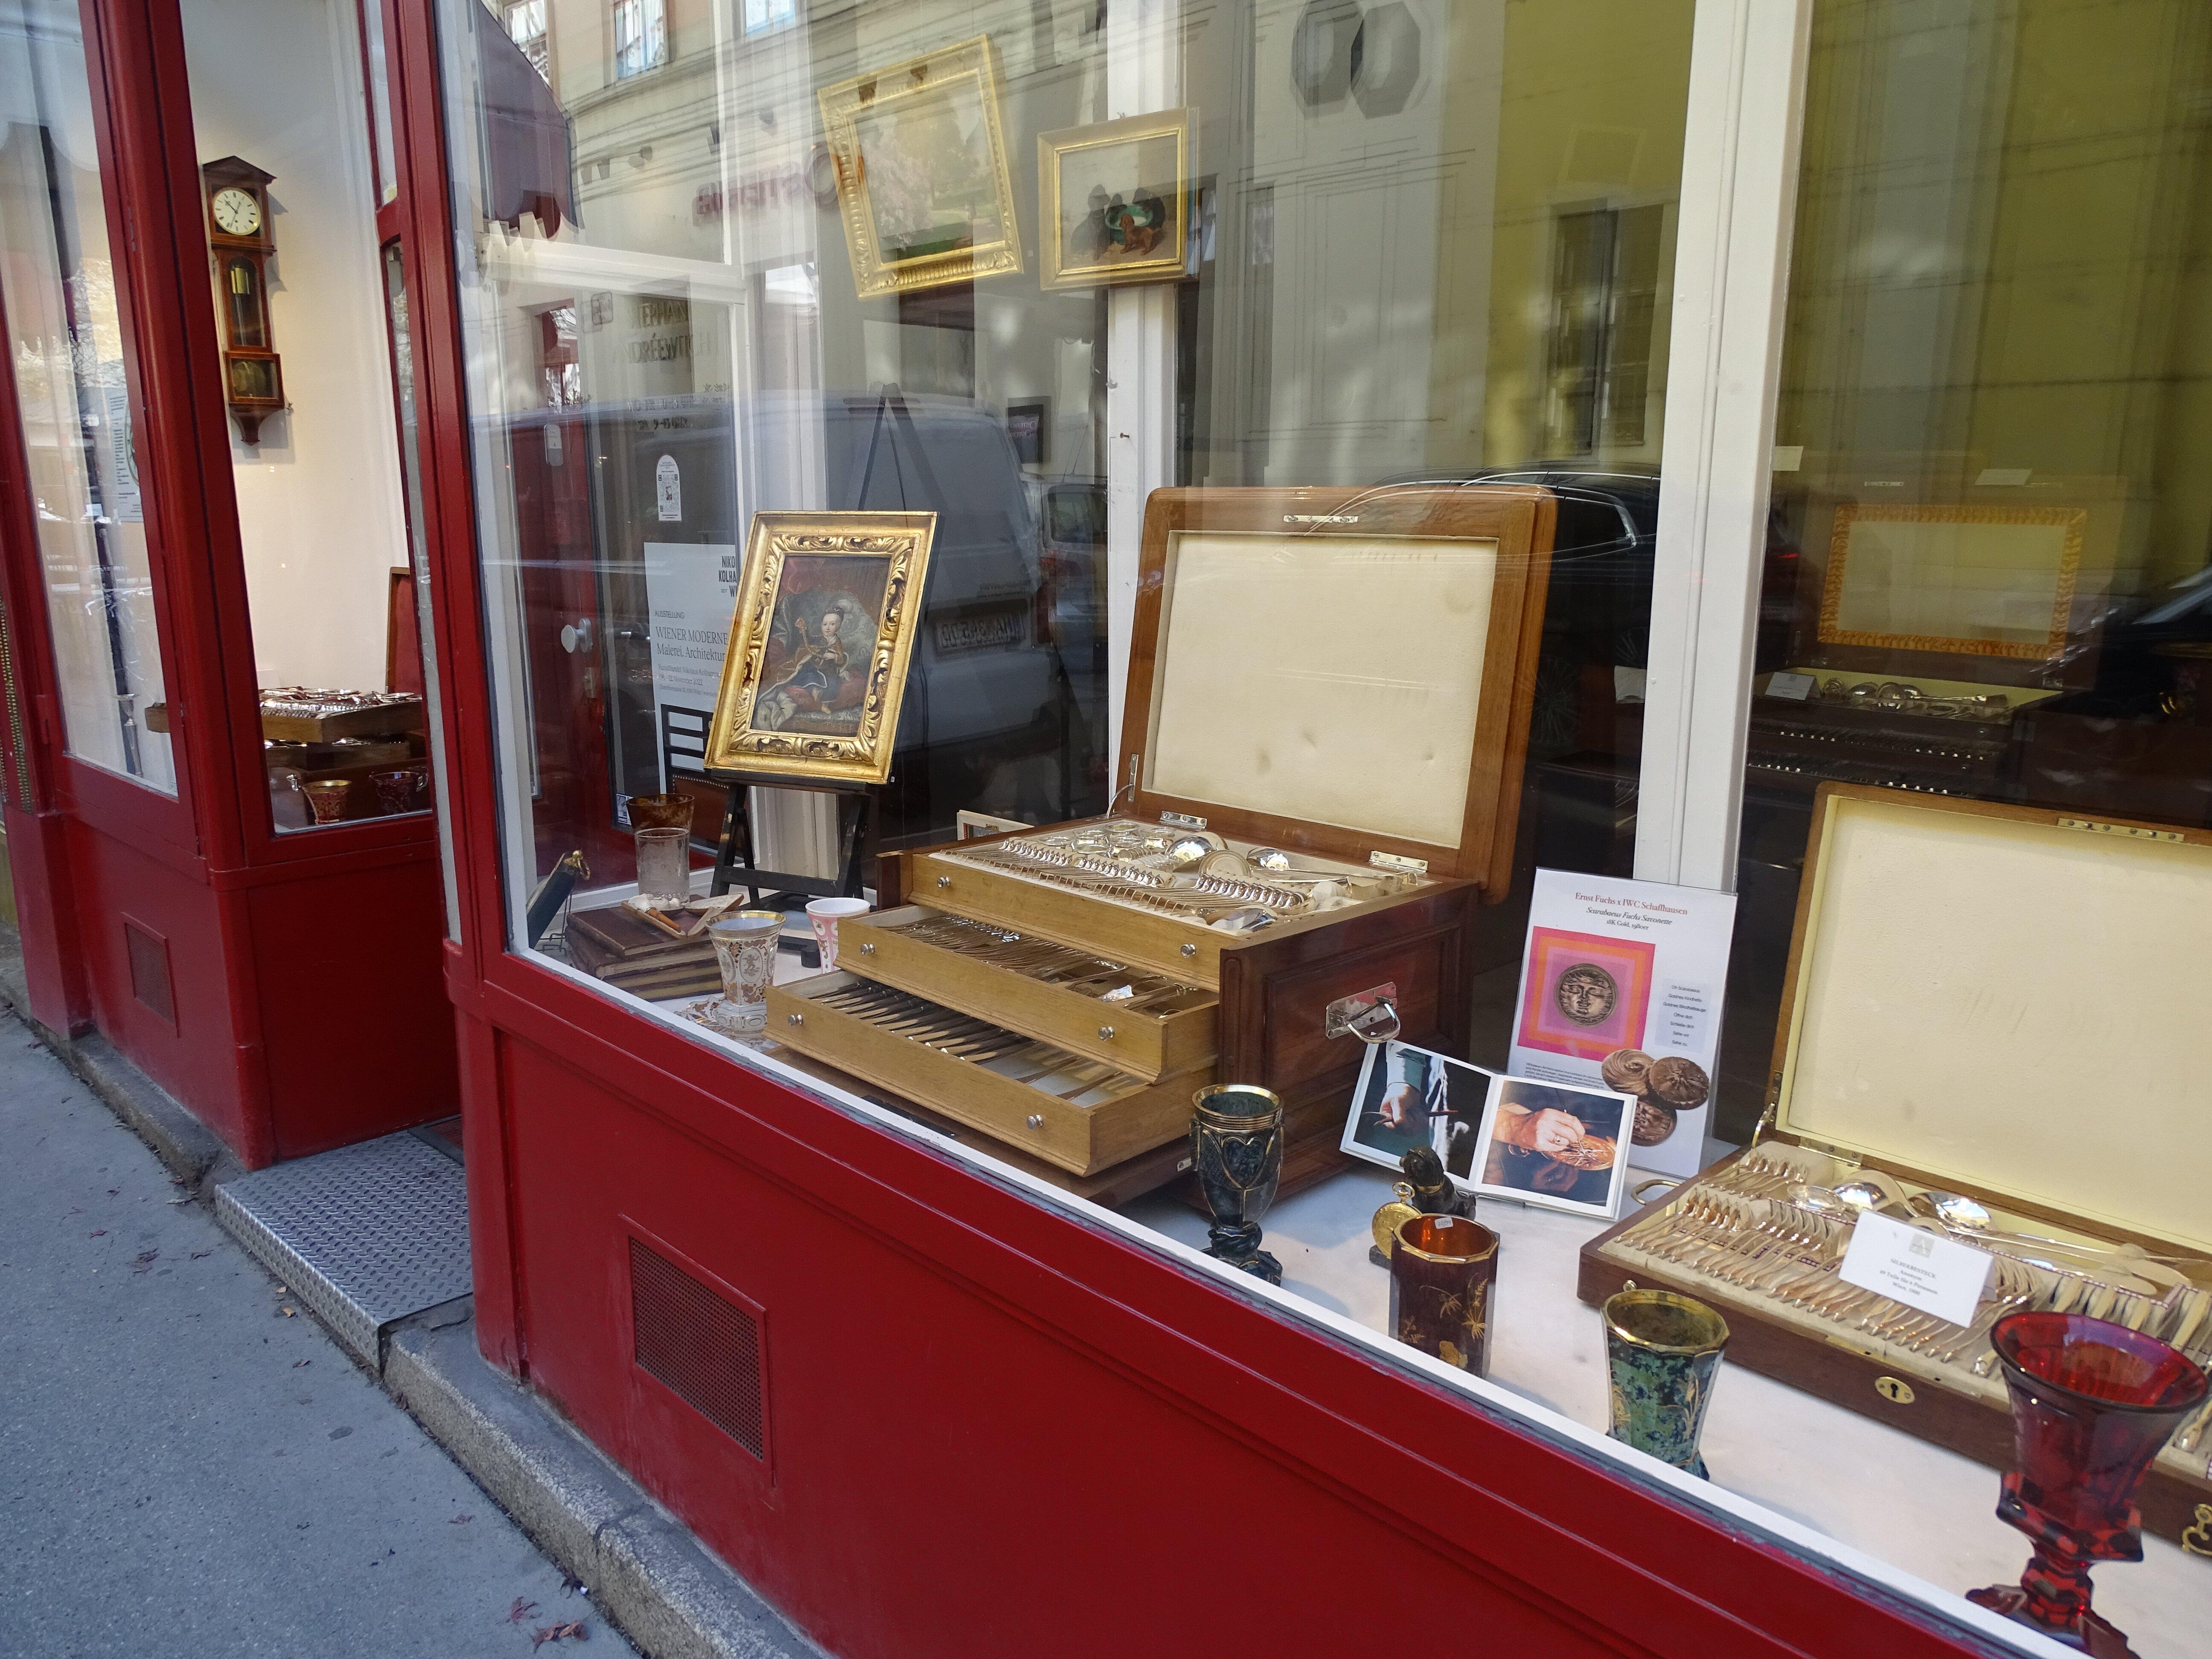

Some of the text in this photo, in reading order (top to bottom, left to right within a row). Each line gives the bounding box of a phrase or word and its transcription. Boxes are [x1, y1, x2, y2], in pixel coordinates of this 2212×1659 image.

[722, 556, 735, 568] NIKO
[655, 610, 685, 619] AUSSTELLUNG
[655, 626, 728, 645] WIENER MODERNE
[657, 643, 725, 661] Malerei. Architektur
[1575, 892, 1593, 901] Ernst
[1595, 895, 1615, 905] Fuchs
[1622, 899, 1640, 908] IWC
[1642, 902, 1688, 915] Schaffhausen
[1586, 907, 1673, 925] Scarabaeus Fuchs Savonette
